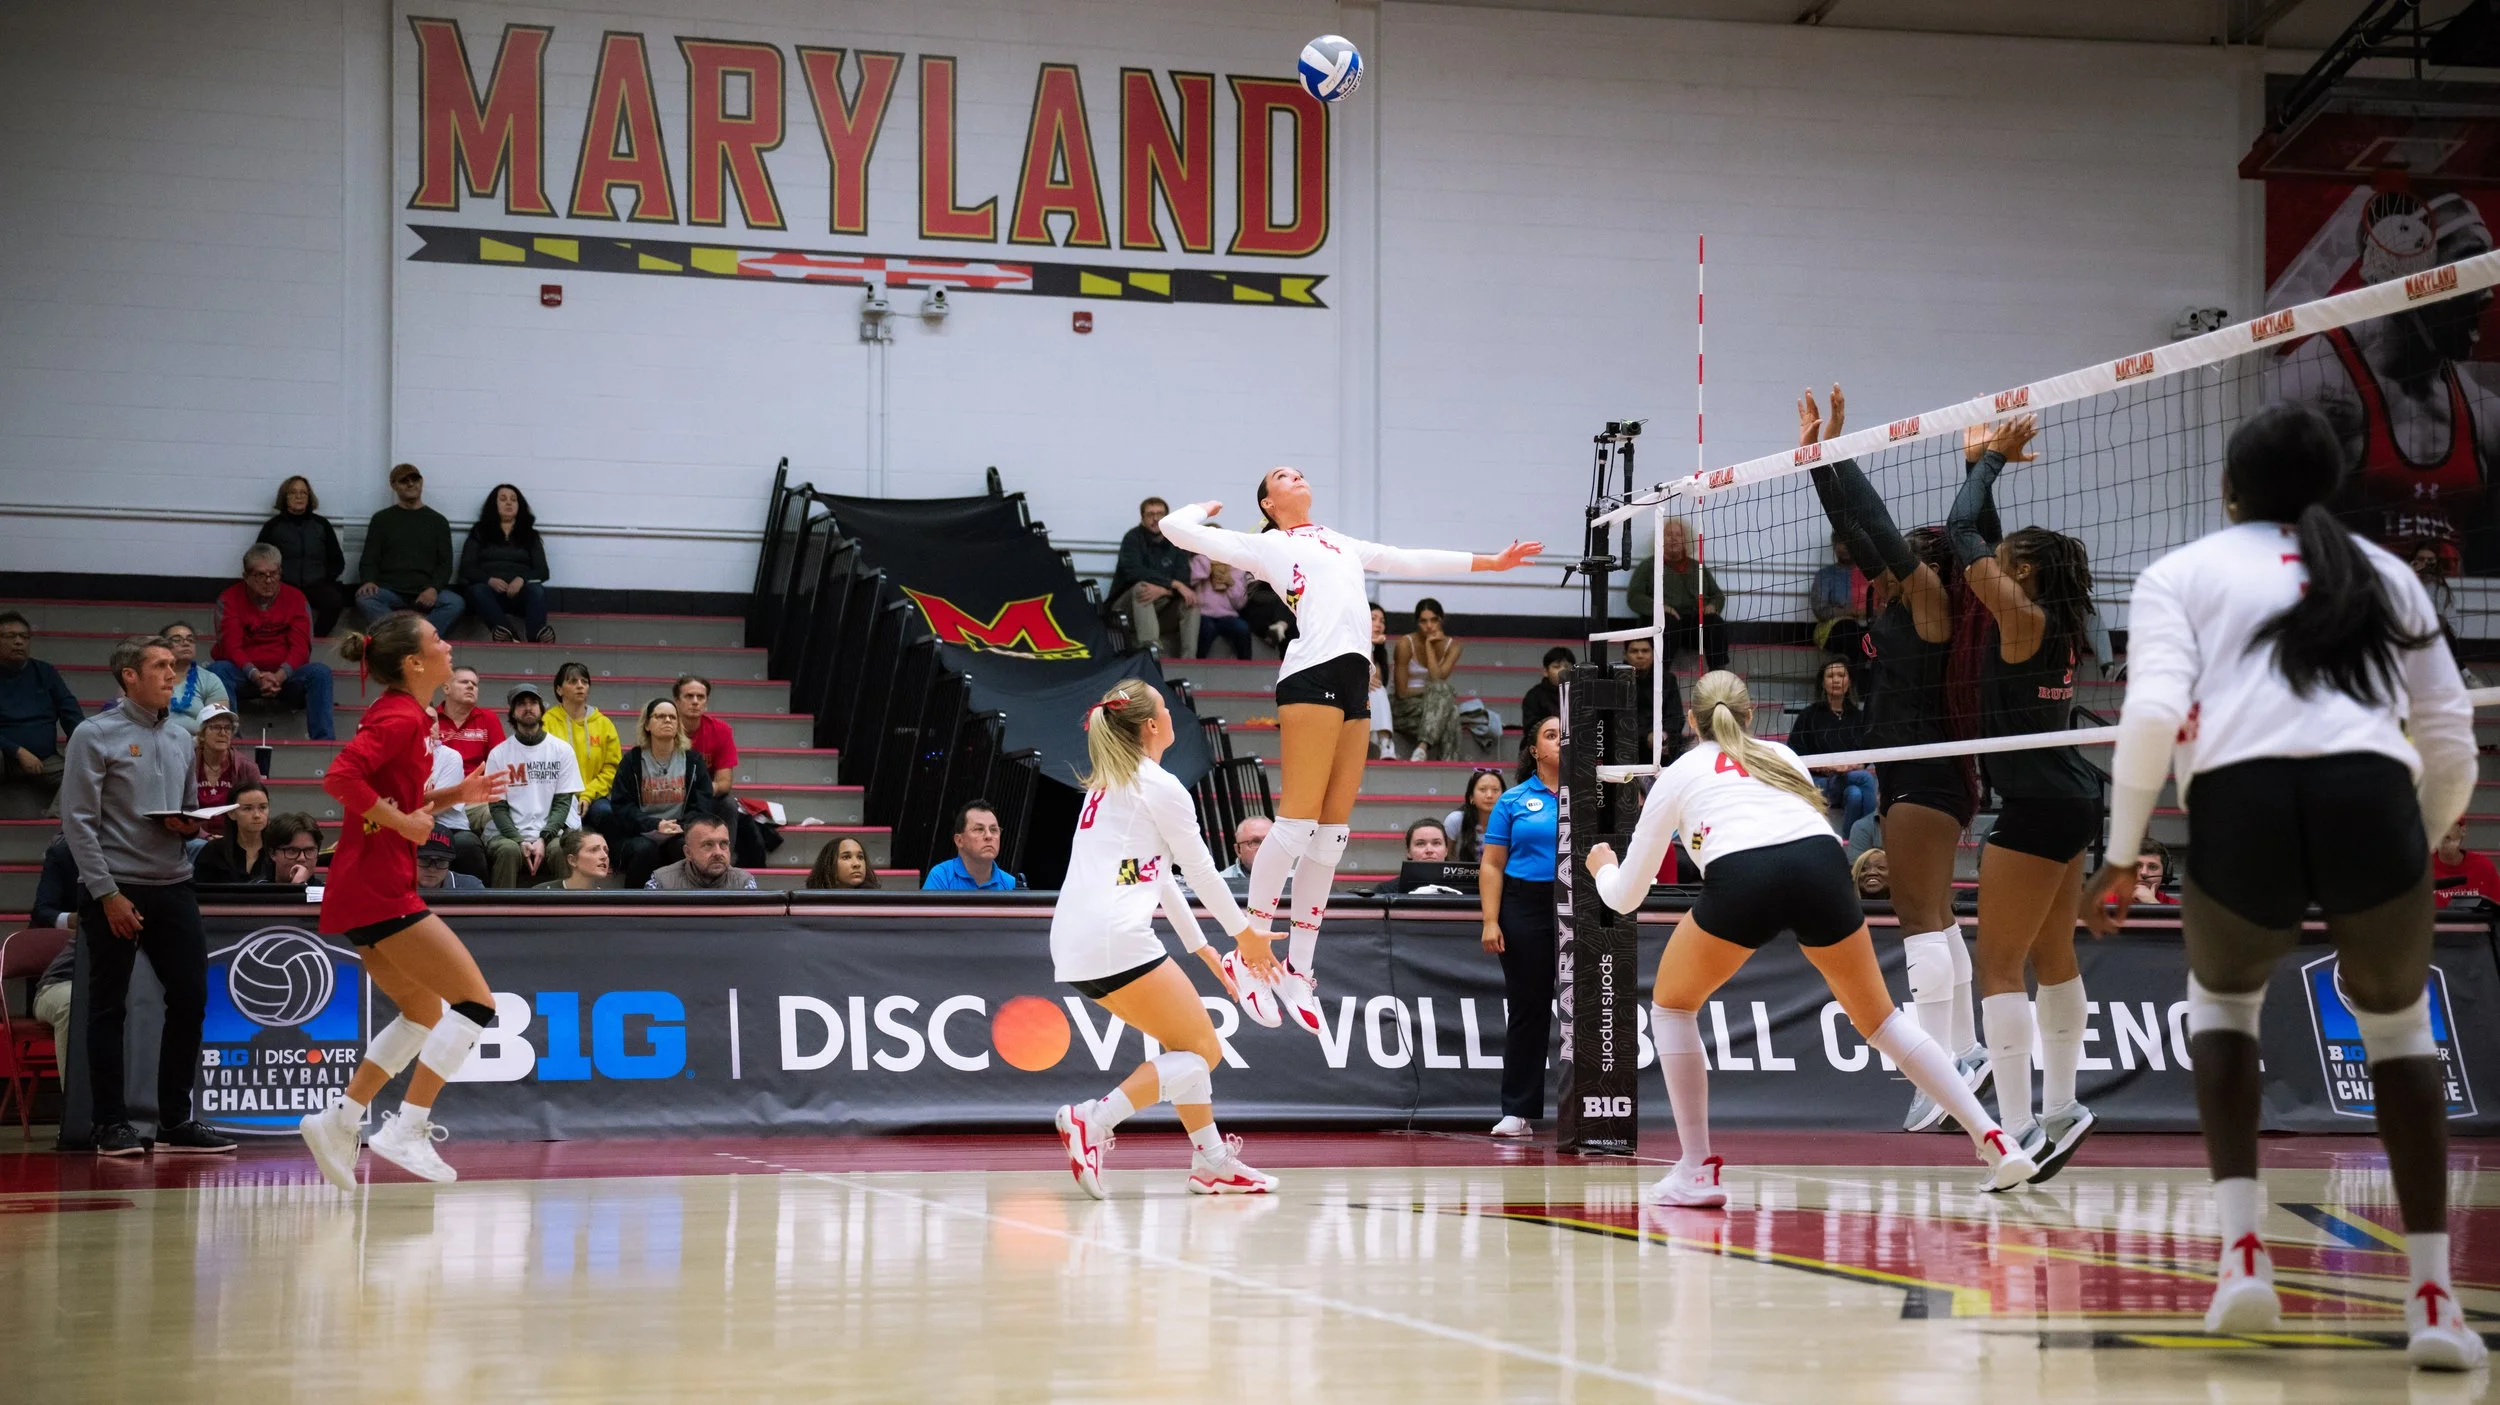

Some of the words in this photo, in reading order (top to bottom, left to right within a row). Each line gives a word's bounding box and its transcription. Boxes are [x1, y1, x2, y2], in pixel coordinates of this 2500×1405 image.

[407, 15, 1330, 258] MARYLAND
[2405, 265, 2458, 297] MARYLAND
[2251, 310, 2294, 338] MARYLAND
[2115, 352, 2154, 377] MARYLAND
[1995, 387, 2030, 410] MARYLAND
[1889, 416, 1920, 438] MARYLAND
[507, 763, 527, 784] M
[527, 761, 561, 771] MARYLAND
[528, 771, 560, 780] TERRAPINS
[1715, 752, 1749, 777] 4
[1080, 784, 1107, 829] 8
[1557, 786, 1574, 1064] MARYLAND
[1600, 954, 1614, 1003] sports
[1600, 1008, 1614, 1072] imports
